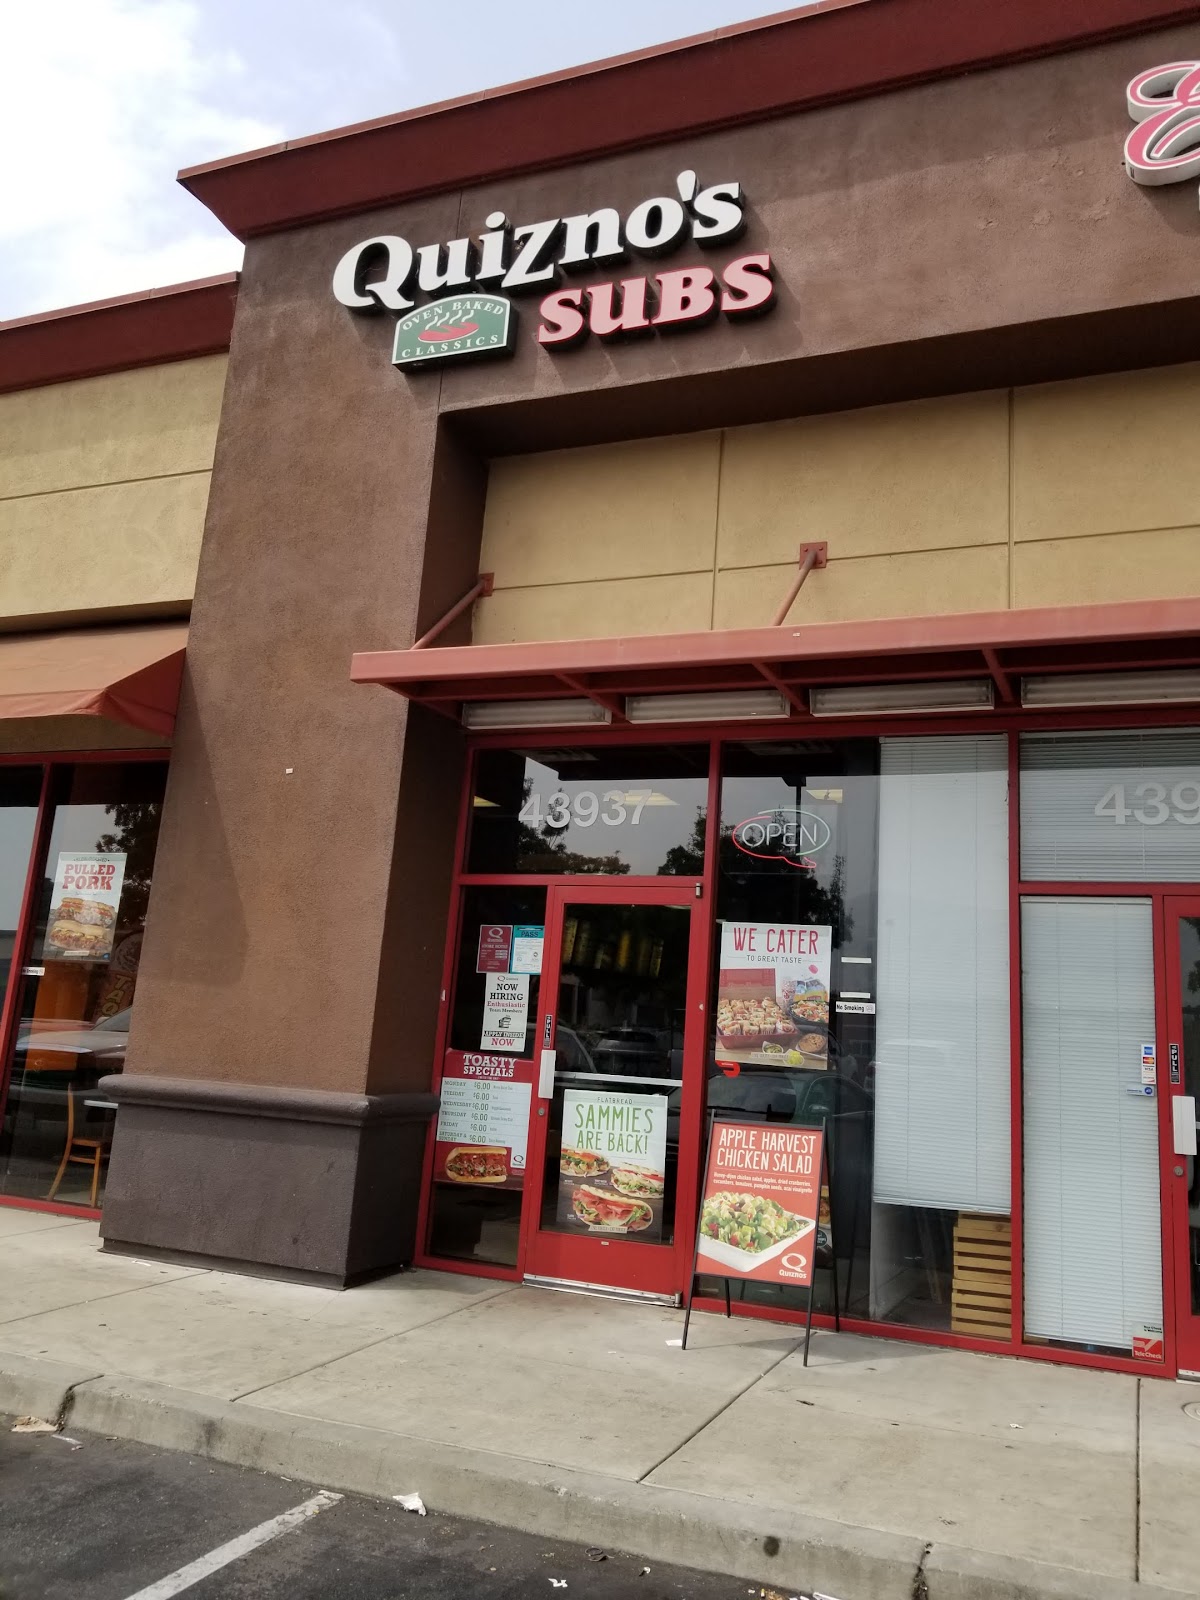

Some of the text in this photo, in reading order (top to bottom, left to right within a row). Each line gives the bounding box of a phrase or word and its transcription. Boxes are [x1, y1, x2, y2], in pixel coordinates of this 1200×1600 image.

[332, 170, 742, 309] Quizno's
[538, 254, 773, 343] SUBS
[402, 297, 504, 331] OVEN BAKED
[401, 334, 498, 358] CLASSICS
[518, 789, 652, 829] 43937
[742, 823, 817, 847] OPEN
[64, 864, 116, 875] PULLED
[62, 876, 113, 890] PORK
[521, 930, 539, 938] PASS
[733, 927, 819, 955] WE CATER
[746, 954, 802, 964] TO GREAT TASTE
[496, 983, 519, 991] NOW
[490, 992, 524, 1001] HIRING
[487, 1000, 525, 1008] Enthusiastic
[844, 1004, 864, 1012] Smoking
[491, 1038, 515, 1047] NOW
[463, 1053, 517, 1069] TOASTY
[463, 1066, 514, 1078] SPECIALS
[474, 1082, 491, 1090] $6.00
[473, 1092, 490, 1100] $6.00
[597, 1097, 633, 1105] FLATBREAD
[472, 1103, 489, 1111] $6.00
[441, 1110, 467, 1118] THURSDAY
[471, 1113, 488, 1121] $6.00
[574, 1103, 654, 1133] SAMMIES
[470, 1124, 487, 1132] $6.00
[469, 1135, 486, 1143] $6.00
[576, 1130, 648, 1155] ARE BACK!
[719, 1128, 816, 1154] APPLE HARVEST
[716, 1148, 812, 1174] CHICKEN SALAD
[779, 1269, 807, 1279] Quiznos
[1134, 1350, 1162, 1360] TeleCheck
